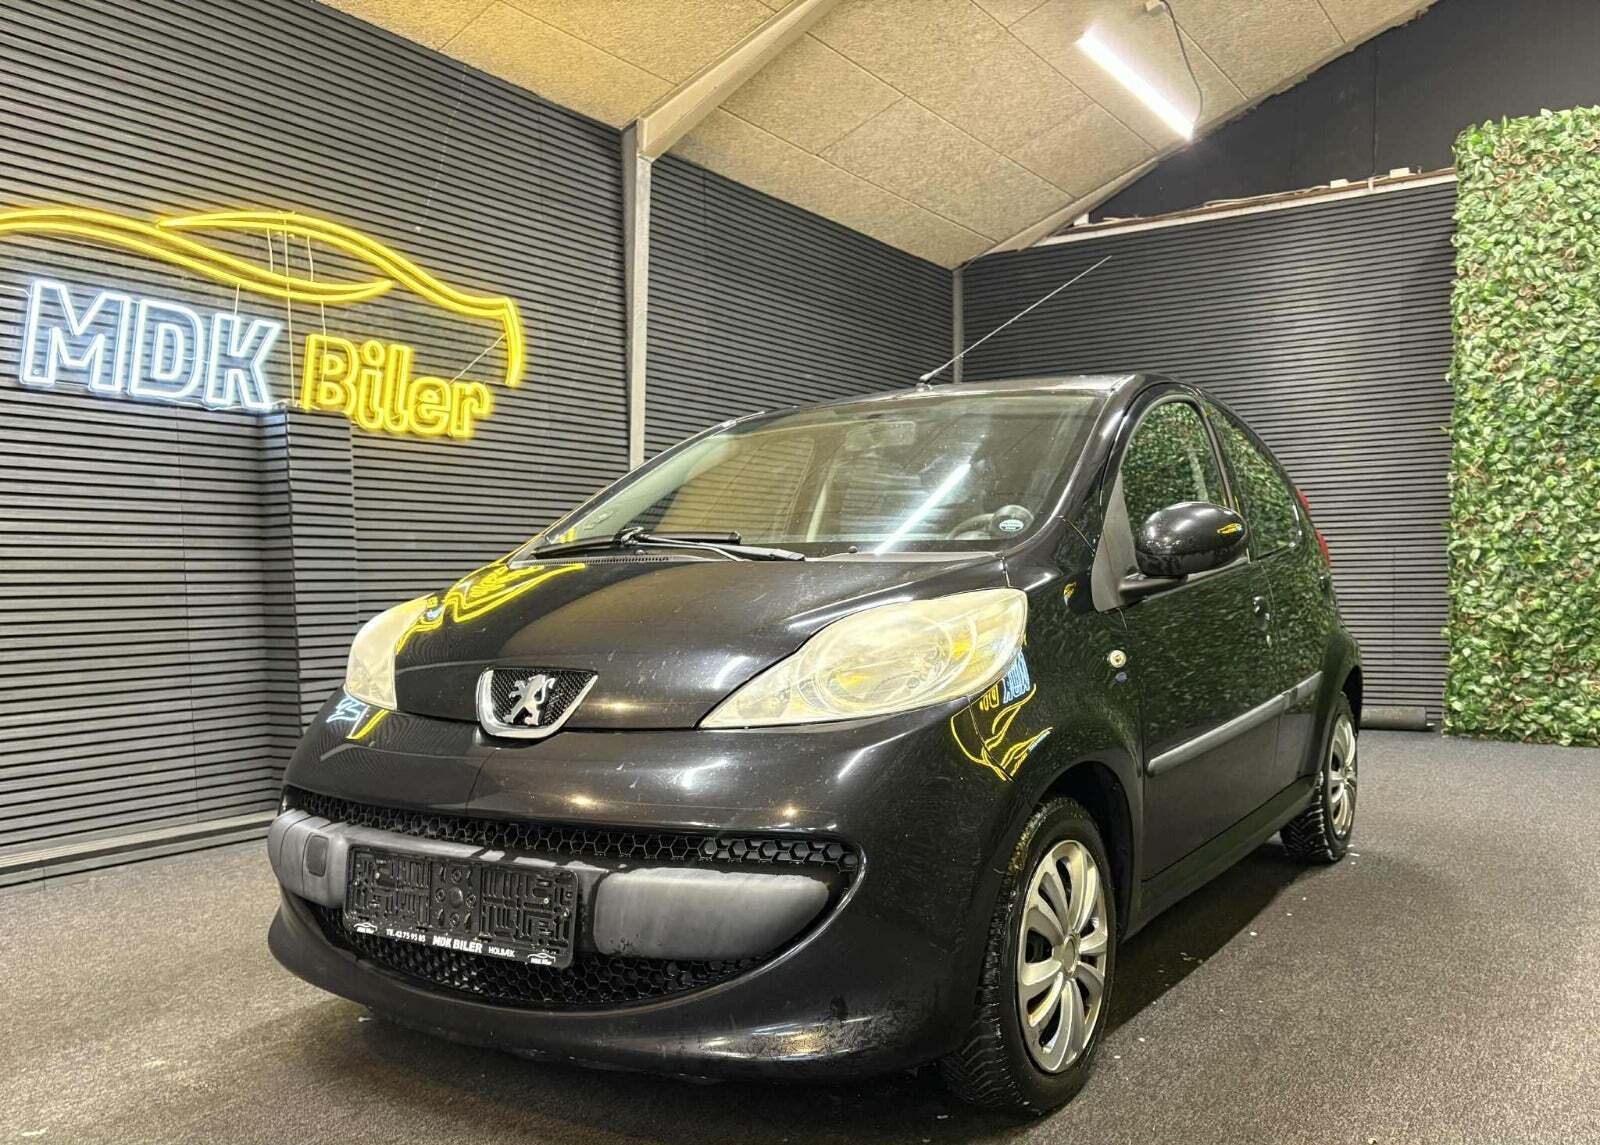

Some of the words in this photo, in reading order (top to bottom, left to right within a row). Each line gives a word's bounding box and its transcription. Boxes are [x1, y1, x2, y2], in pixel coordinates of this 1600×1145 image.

[19, 279, 284, 410] MDK
[302, 333, 492, 438] Biler
[432, 935, 452, 949] MDK
[452, 938, 483, 954] BILER
